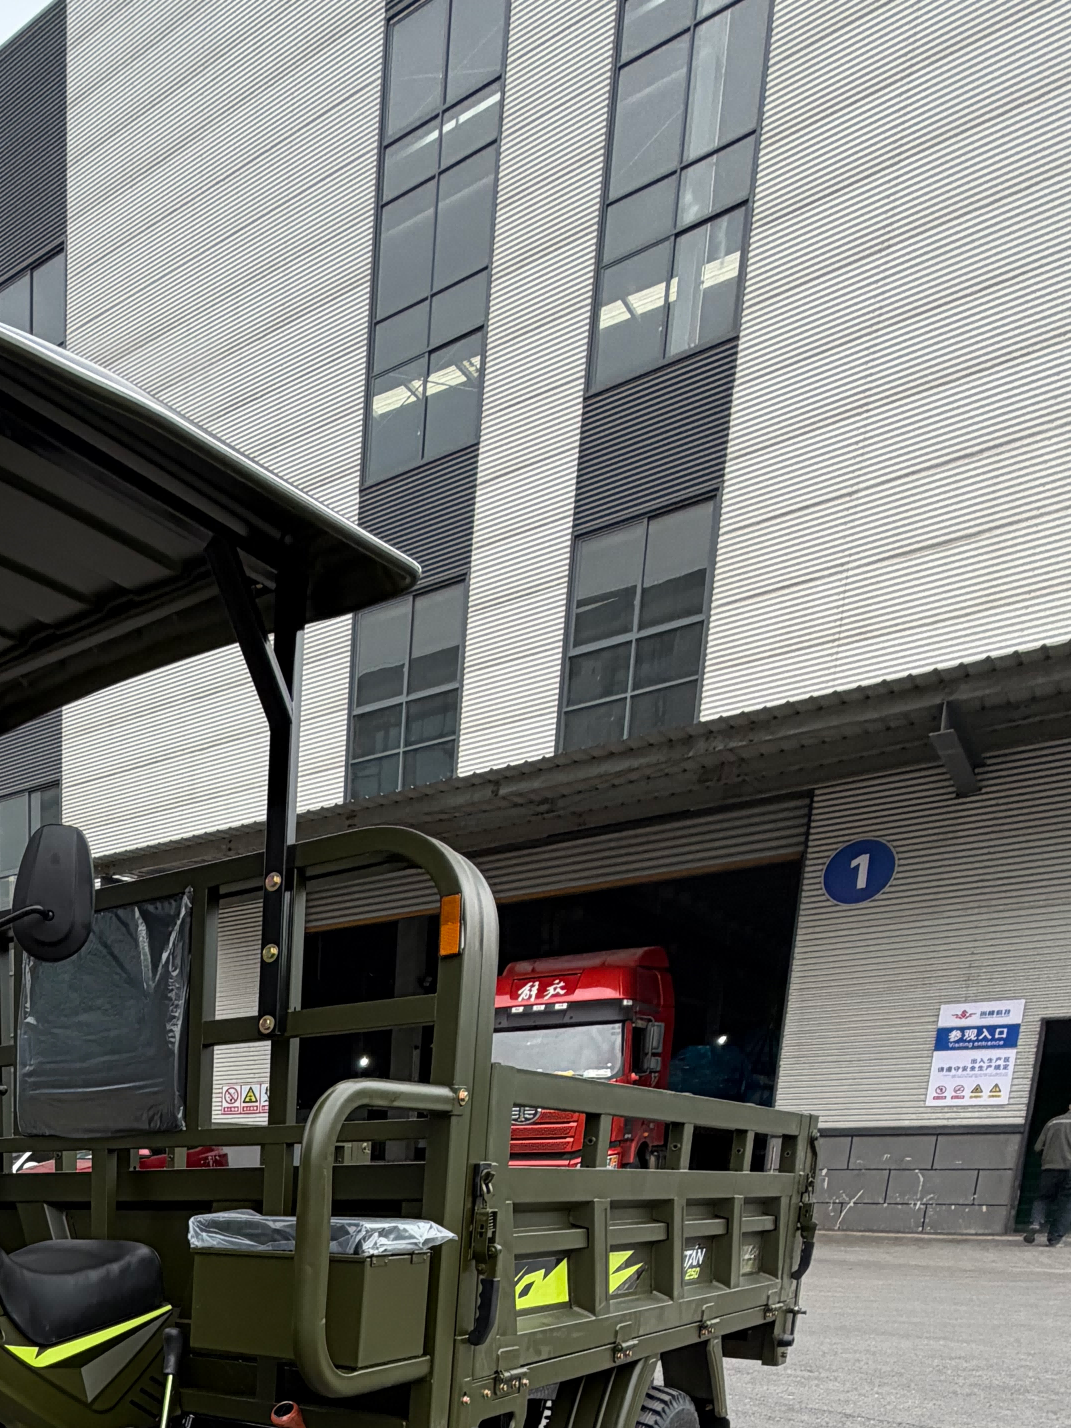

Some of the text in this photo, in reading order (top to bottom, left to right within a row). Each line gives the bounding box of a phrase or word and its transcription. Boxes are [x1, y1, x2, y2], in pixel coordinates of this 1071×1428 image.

[850, 853, 870, 890] 1
[517, 979, 567, 1002] 解放
[948, 1029, 1007, 1042] 参观入口
[685, 1267, 701, 1280] 250
